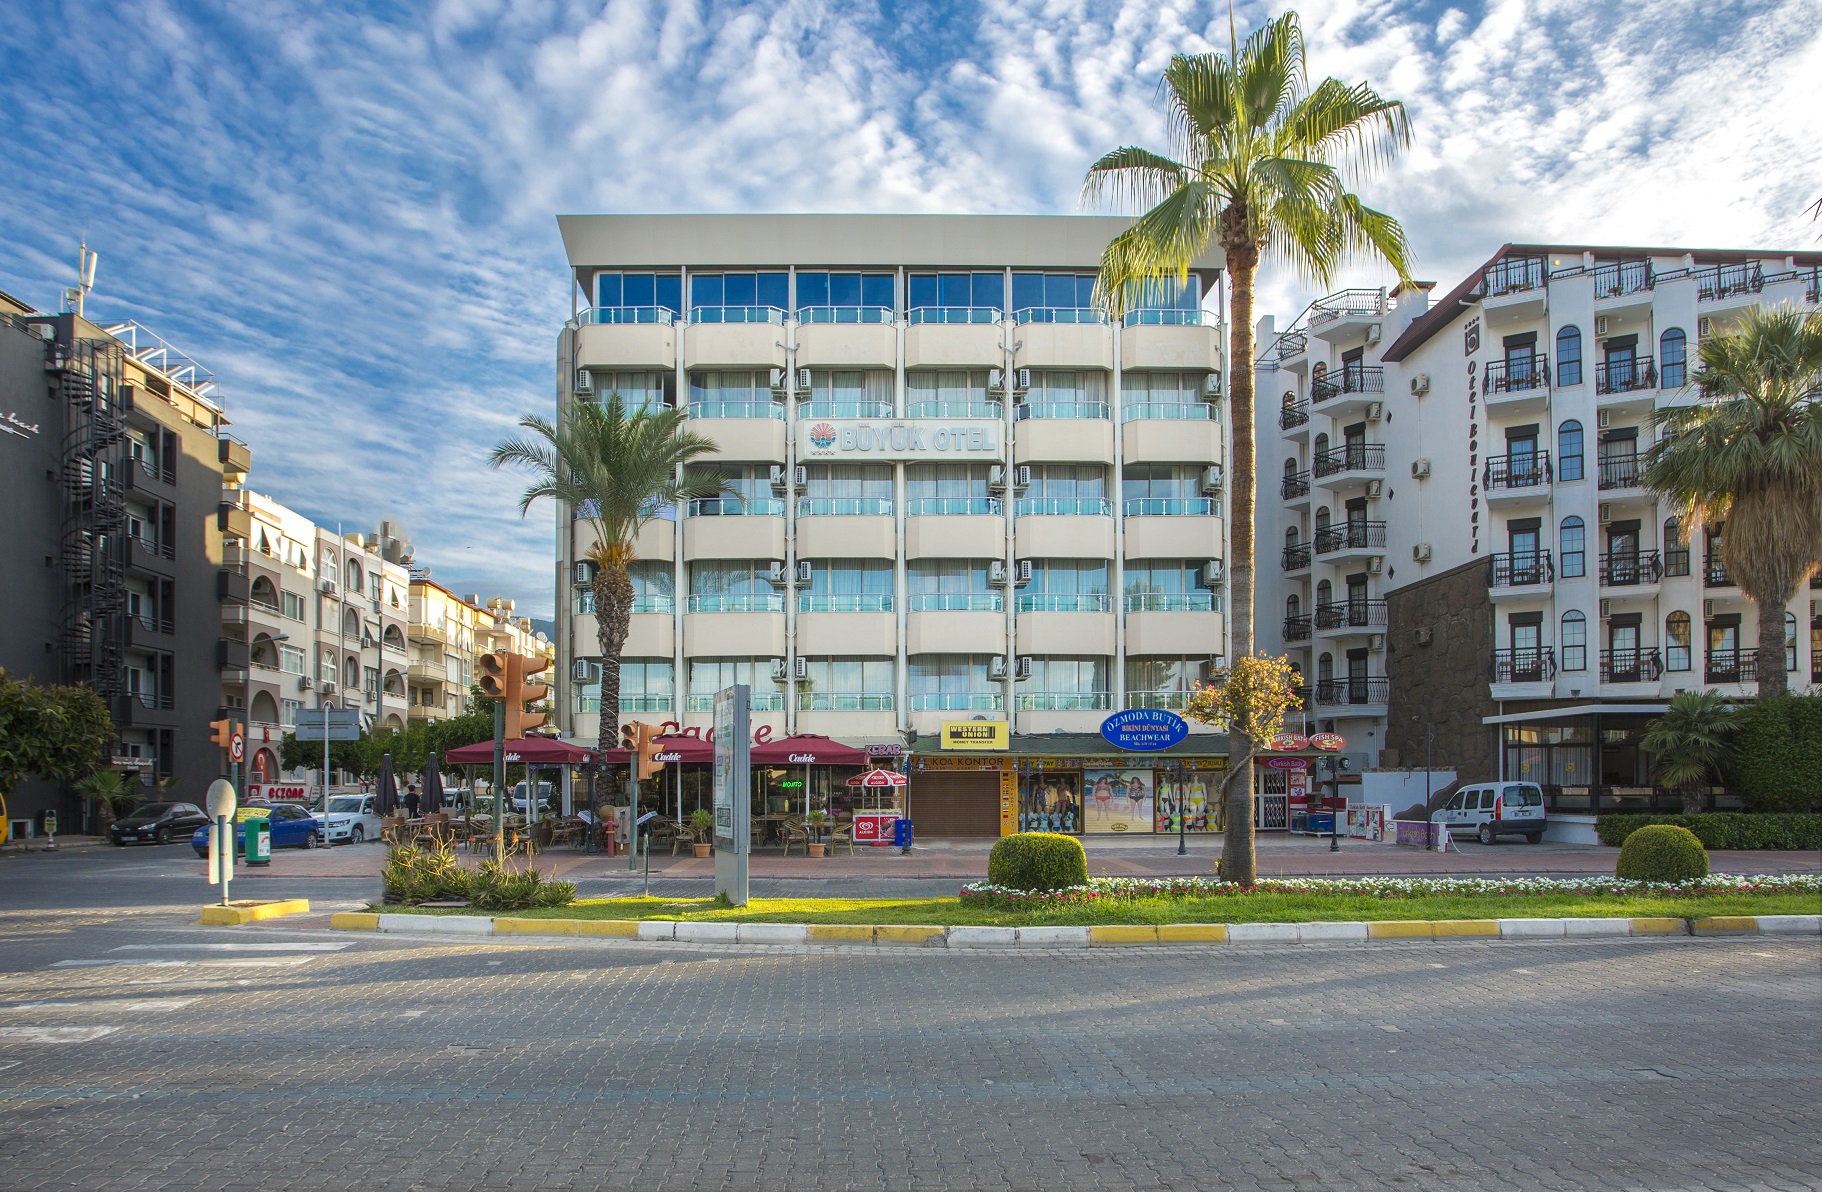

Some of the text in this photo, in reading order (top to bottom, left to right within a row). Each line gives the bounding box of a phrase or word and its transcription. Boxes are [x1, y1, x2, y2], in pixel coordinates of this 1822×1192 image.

[841, 422, 996, 451] BÜYÜK OTEL
[1467, 360, 1479, 554] Otel Boulevard
[1106, 711, 1184, 733] ÖZMODA BUTİK
[1142, 724, 1169, 732] DÜNYASI
[1120, 733, 1171, 742] BEACHWEAR
[1273, 734, 1293, 743] URKISH
[1293, 735, 1308, 743] BATH
[1315, 734, 1330, 742] FISH
[1331, 734, 1344, 743] SPA
[865, 744, 901, 756] KEBAB
[654, 752, 682, 762] Cadde
[788, 753, 816, 763] Cadde
[957, 758, 1005, 766] KONTOR
[1202, 759, 1208, 767] 2
[268, 787, 304, 799] eczane
